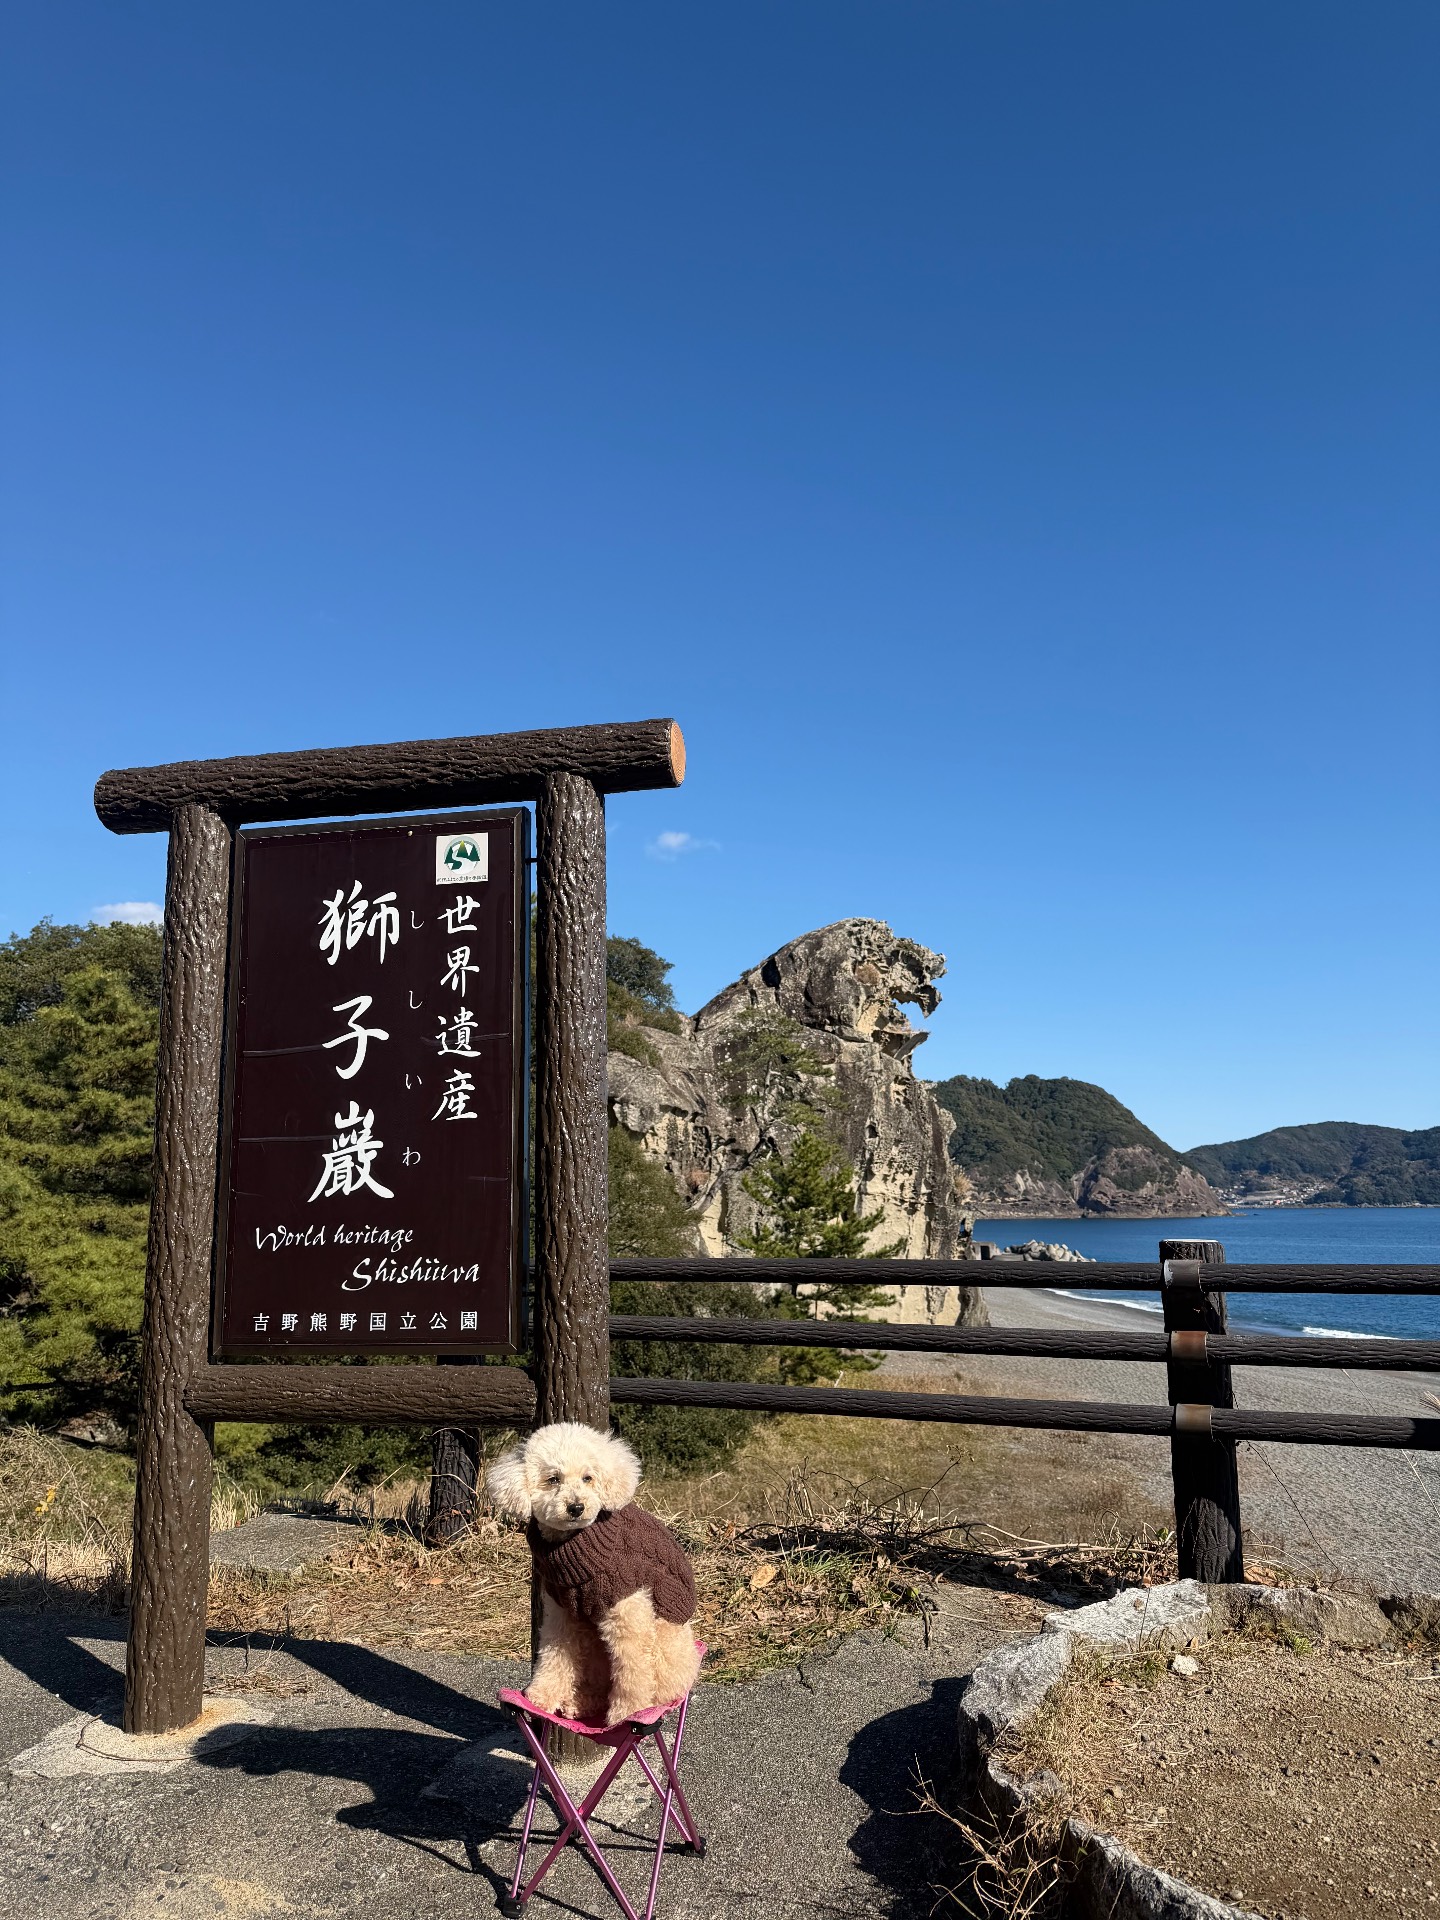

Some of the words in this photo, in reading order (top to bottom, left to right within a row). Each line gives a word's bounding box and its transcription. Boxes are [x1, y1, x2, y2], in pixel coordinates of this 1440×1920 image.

[431, 895, 482, 1121] 世界遺産
[402, 909, 425, 1167] ししいわ
[255, 1224, 327, 1252] World
[333, 1223, 414, 1253] heritage
[341, 1256, 480, 1291] Shishiiwa
[252, 1310, 478, 1332] 吉野熊野国立公園
